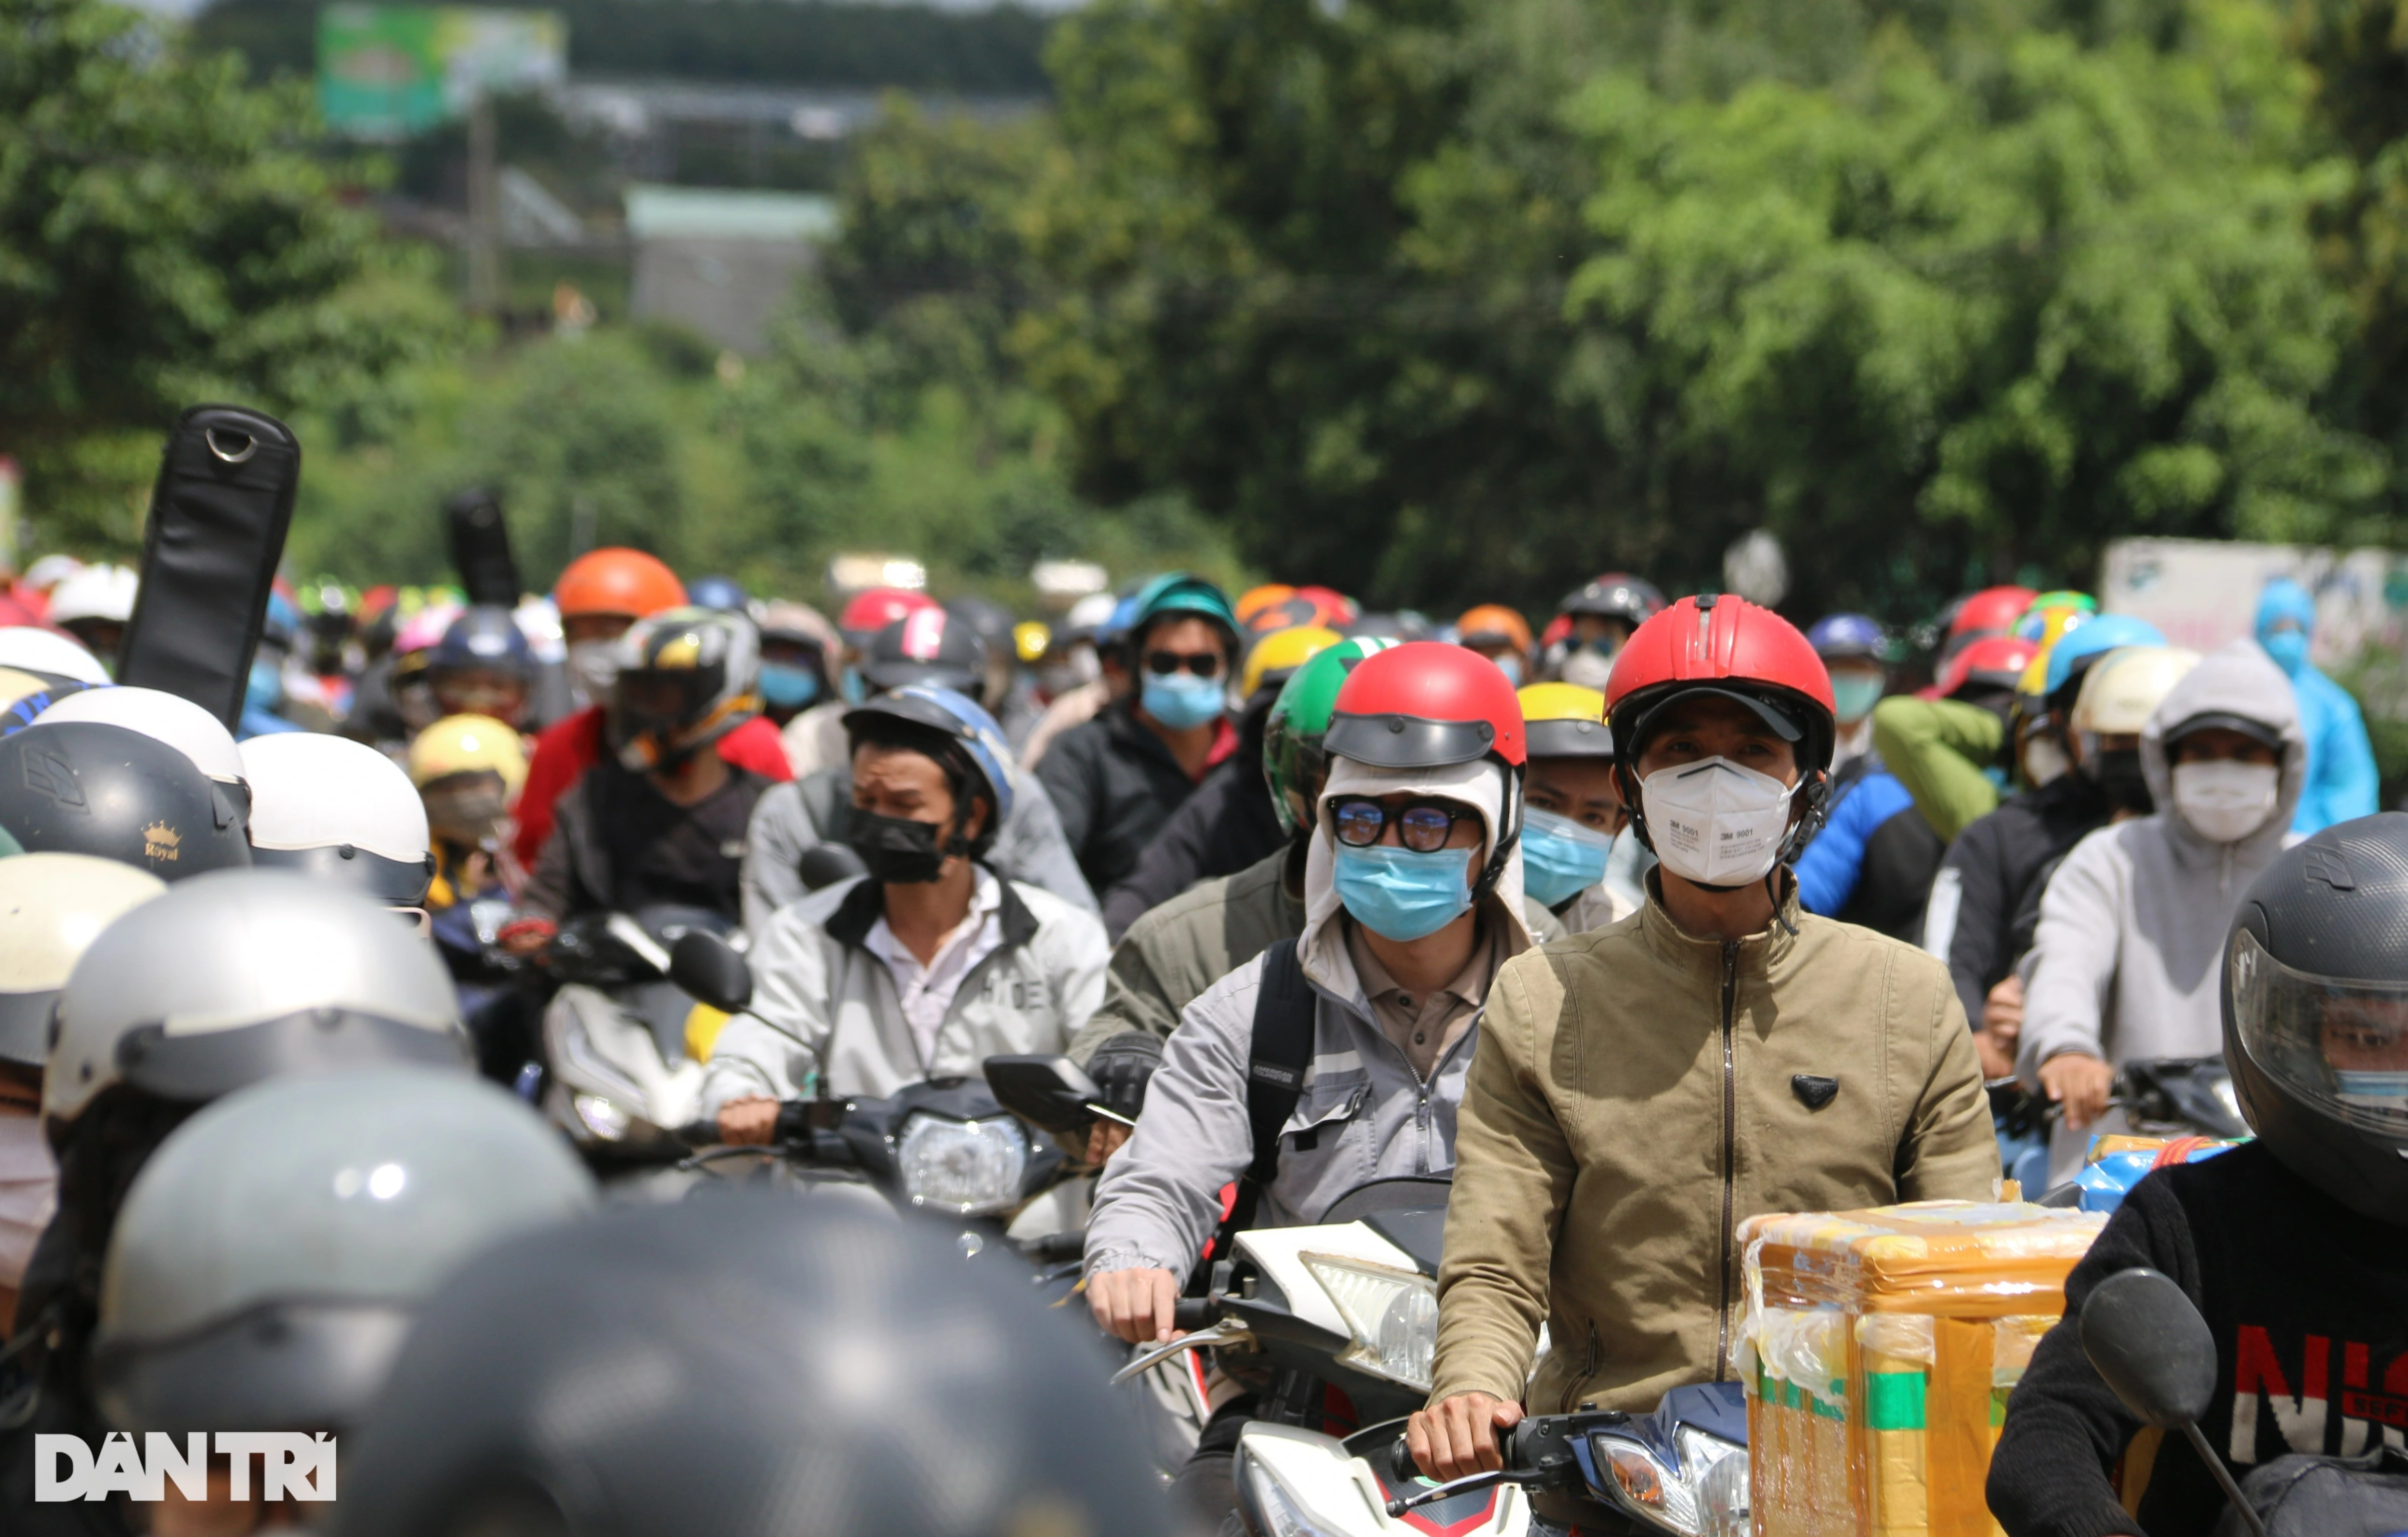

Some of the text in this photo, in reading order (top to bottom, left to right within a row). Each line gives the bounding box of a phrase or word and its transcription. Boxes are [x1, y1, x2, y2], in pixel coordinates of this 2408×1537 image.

[1670, 819, 1698, 837] 3M 9001
[1720, 828, 1753, 841] 3M 9001
[145, 842, 178, 861] Royal
